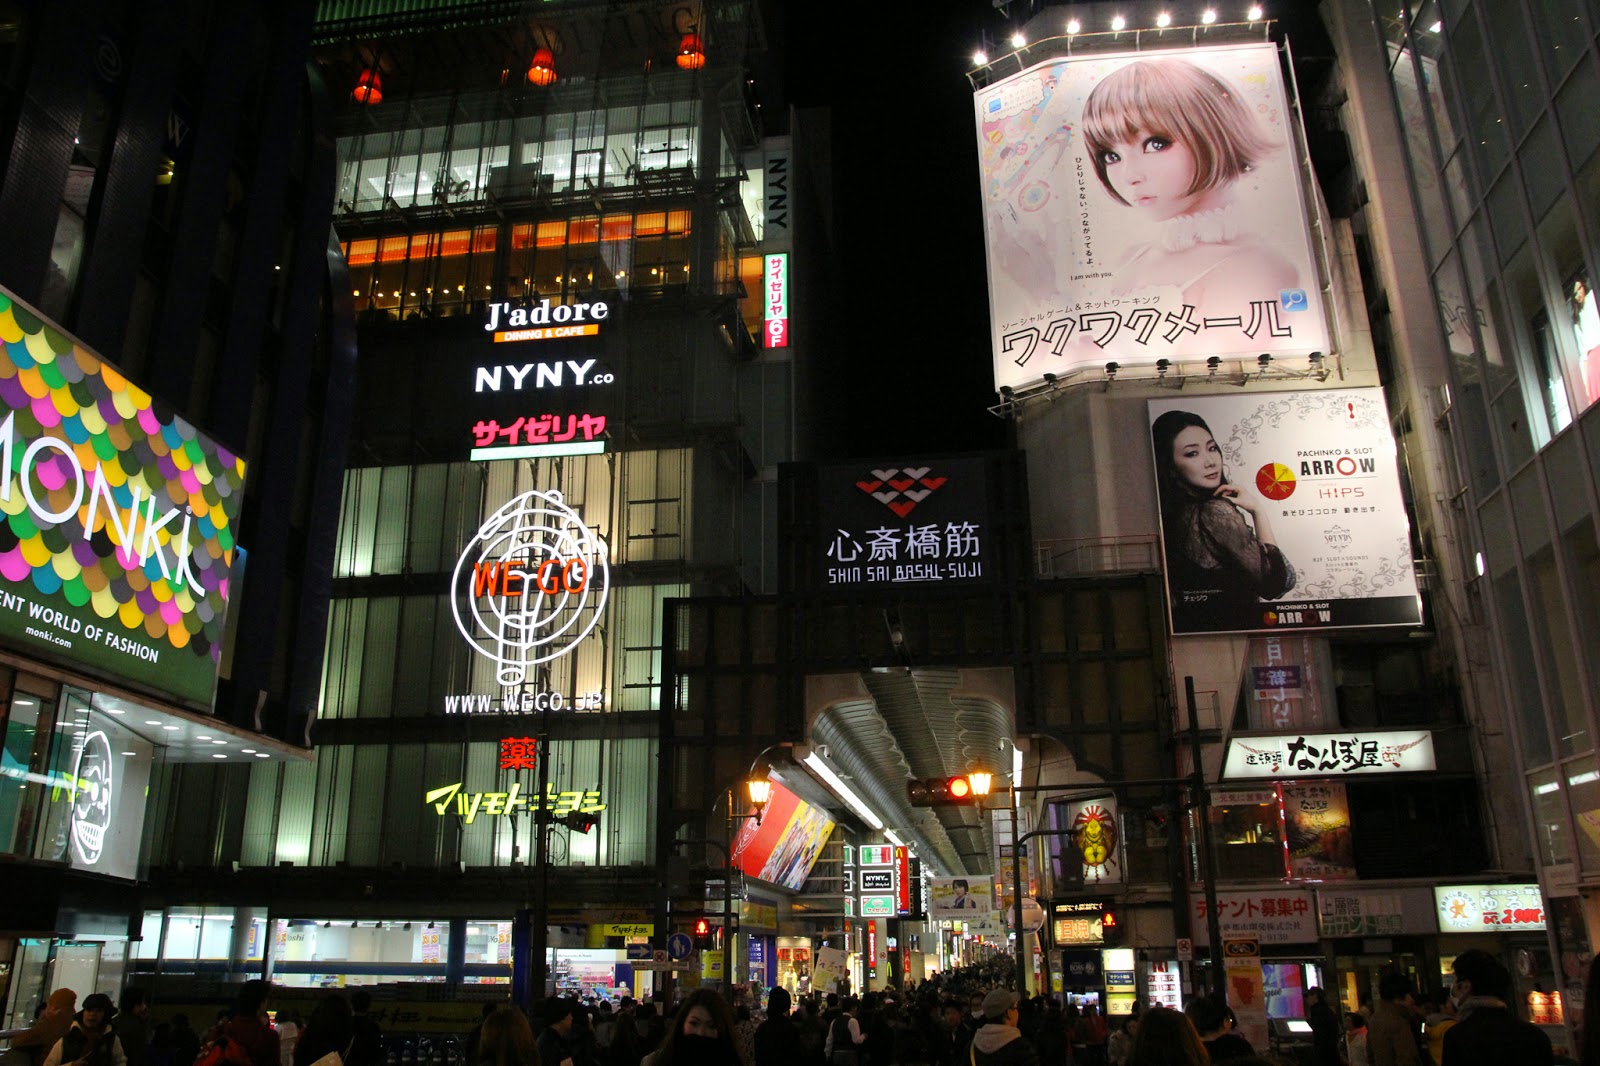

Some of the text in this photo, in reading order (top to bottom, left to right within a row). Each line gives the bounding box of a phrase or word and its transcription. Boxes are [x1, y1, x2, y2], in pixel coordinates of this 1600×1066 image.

[769, 158, 787, 228] NYNY
[770, 257, 782, 316] サイゼリヤ
[484, 299, 608, 331] J'adore
[1002, 295, 1161, 331] ソーシャルゲーム & ネットワーキング
[504, 325, 585, 341] DINING & CAFE
[769, 319, 784, 347] 6F
[1002, 300, 1293, 368] ワクワクメール
[475, 359, 614, 392] NYNY.co
[472, 414, 607, 447] サイゼリヤ
[1297, 448, 1341, 457] PACHINKO
[1354, 447, 1373, 455] SLOT
[1301, 456, 1375, 476] ARROW
[826, 521, 980, 562] 心斎橋筋
[474, 558, 587, 598] WE GO
[828, 567, 861, 584] SHIN
[867, 565, 889, 582] SAI
[1276, 603, 1308, 611] PACHINKO
[25, 626, 72, 649] monki.com
[29, 601, 81, 634] WORLD
[84, 624, 104, 642] OF
[105, 631, 159, 664] FASHION
[444, 692, 603, 714] WWW.WEGO.JP
[500, 736, 537, 770] 薬
[1287, 736, 1383, 773] なんぼ屋
[426, 782, 607, 824] マツモトキヨシ
[1322, 896, 1360, 916] 上層階
